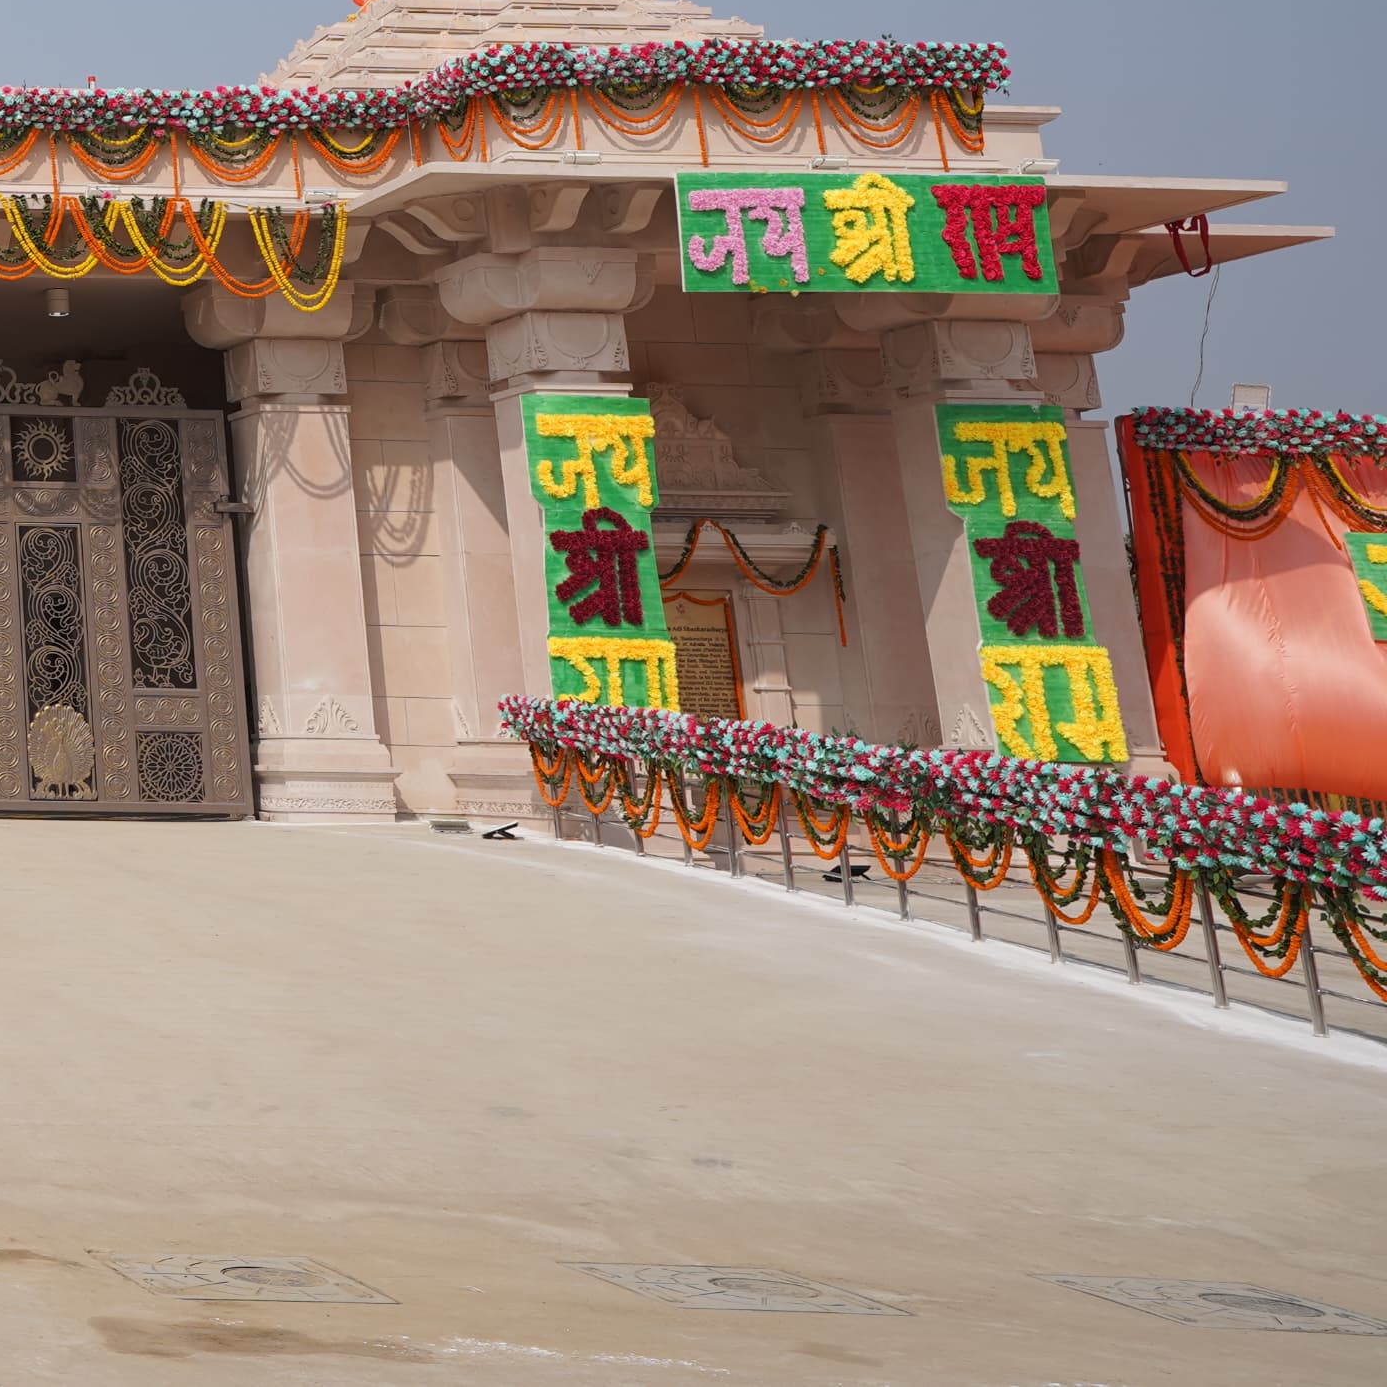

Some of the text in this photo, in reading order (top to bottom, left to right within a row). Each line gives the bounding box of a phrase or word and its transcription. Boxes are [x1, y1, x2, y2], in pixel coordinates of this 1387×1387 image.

[687, 172, 1046, 285] जय श्री राम
[535, 413, 656, 510] जय
[940, 421, 1068, 520] जय
[548, 506, 650, 628] श्री
[972, 520, 1082, 639] श्री
[978, 644, 1131, 763] राम
